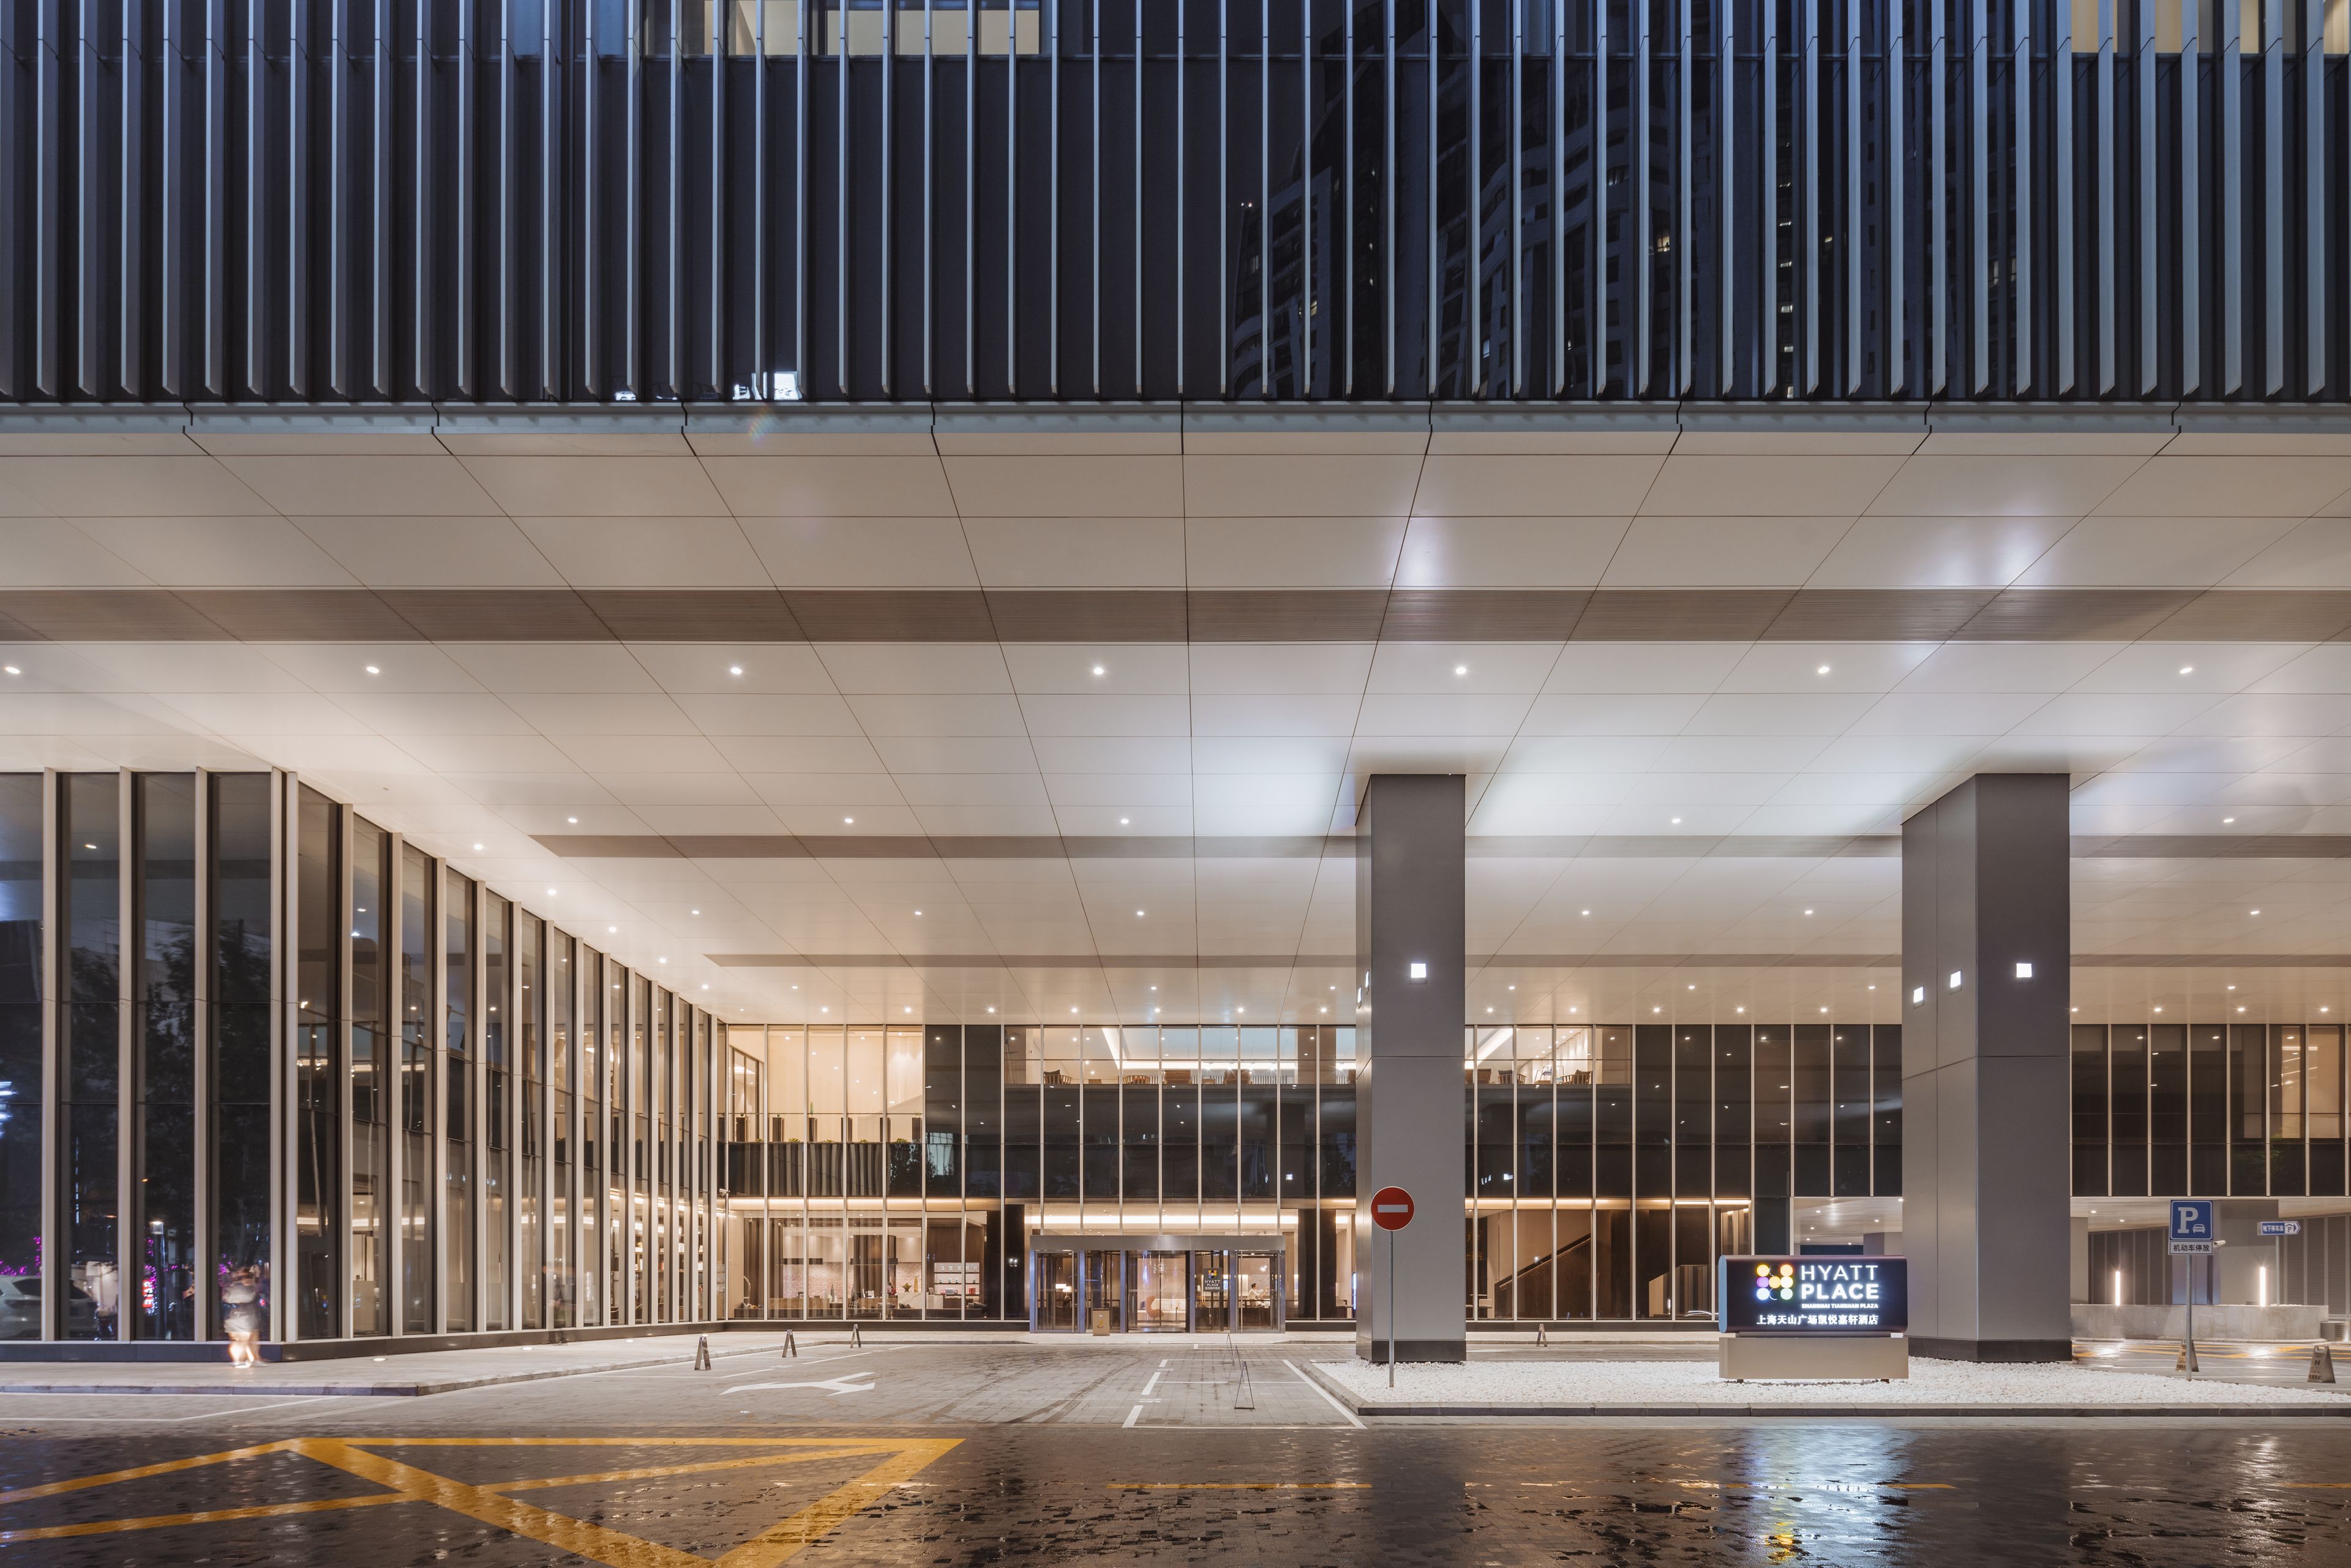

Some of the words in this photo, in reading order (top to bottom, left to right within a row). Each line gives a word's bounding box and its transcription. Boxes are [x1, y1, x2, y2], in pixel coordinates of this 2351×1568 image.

[2178, 1207, 2199, 1233] P
[1801, 1265, 1878, 1280] HYATT
[1801, 1284, 1878, 1299] PLACE
[1757, 1315, 1878, 1325] 上海天山广场凯悦嘉轩酒店
